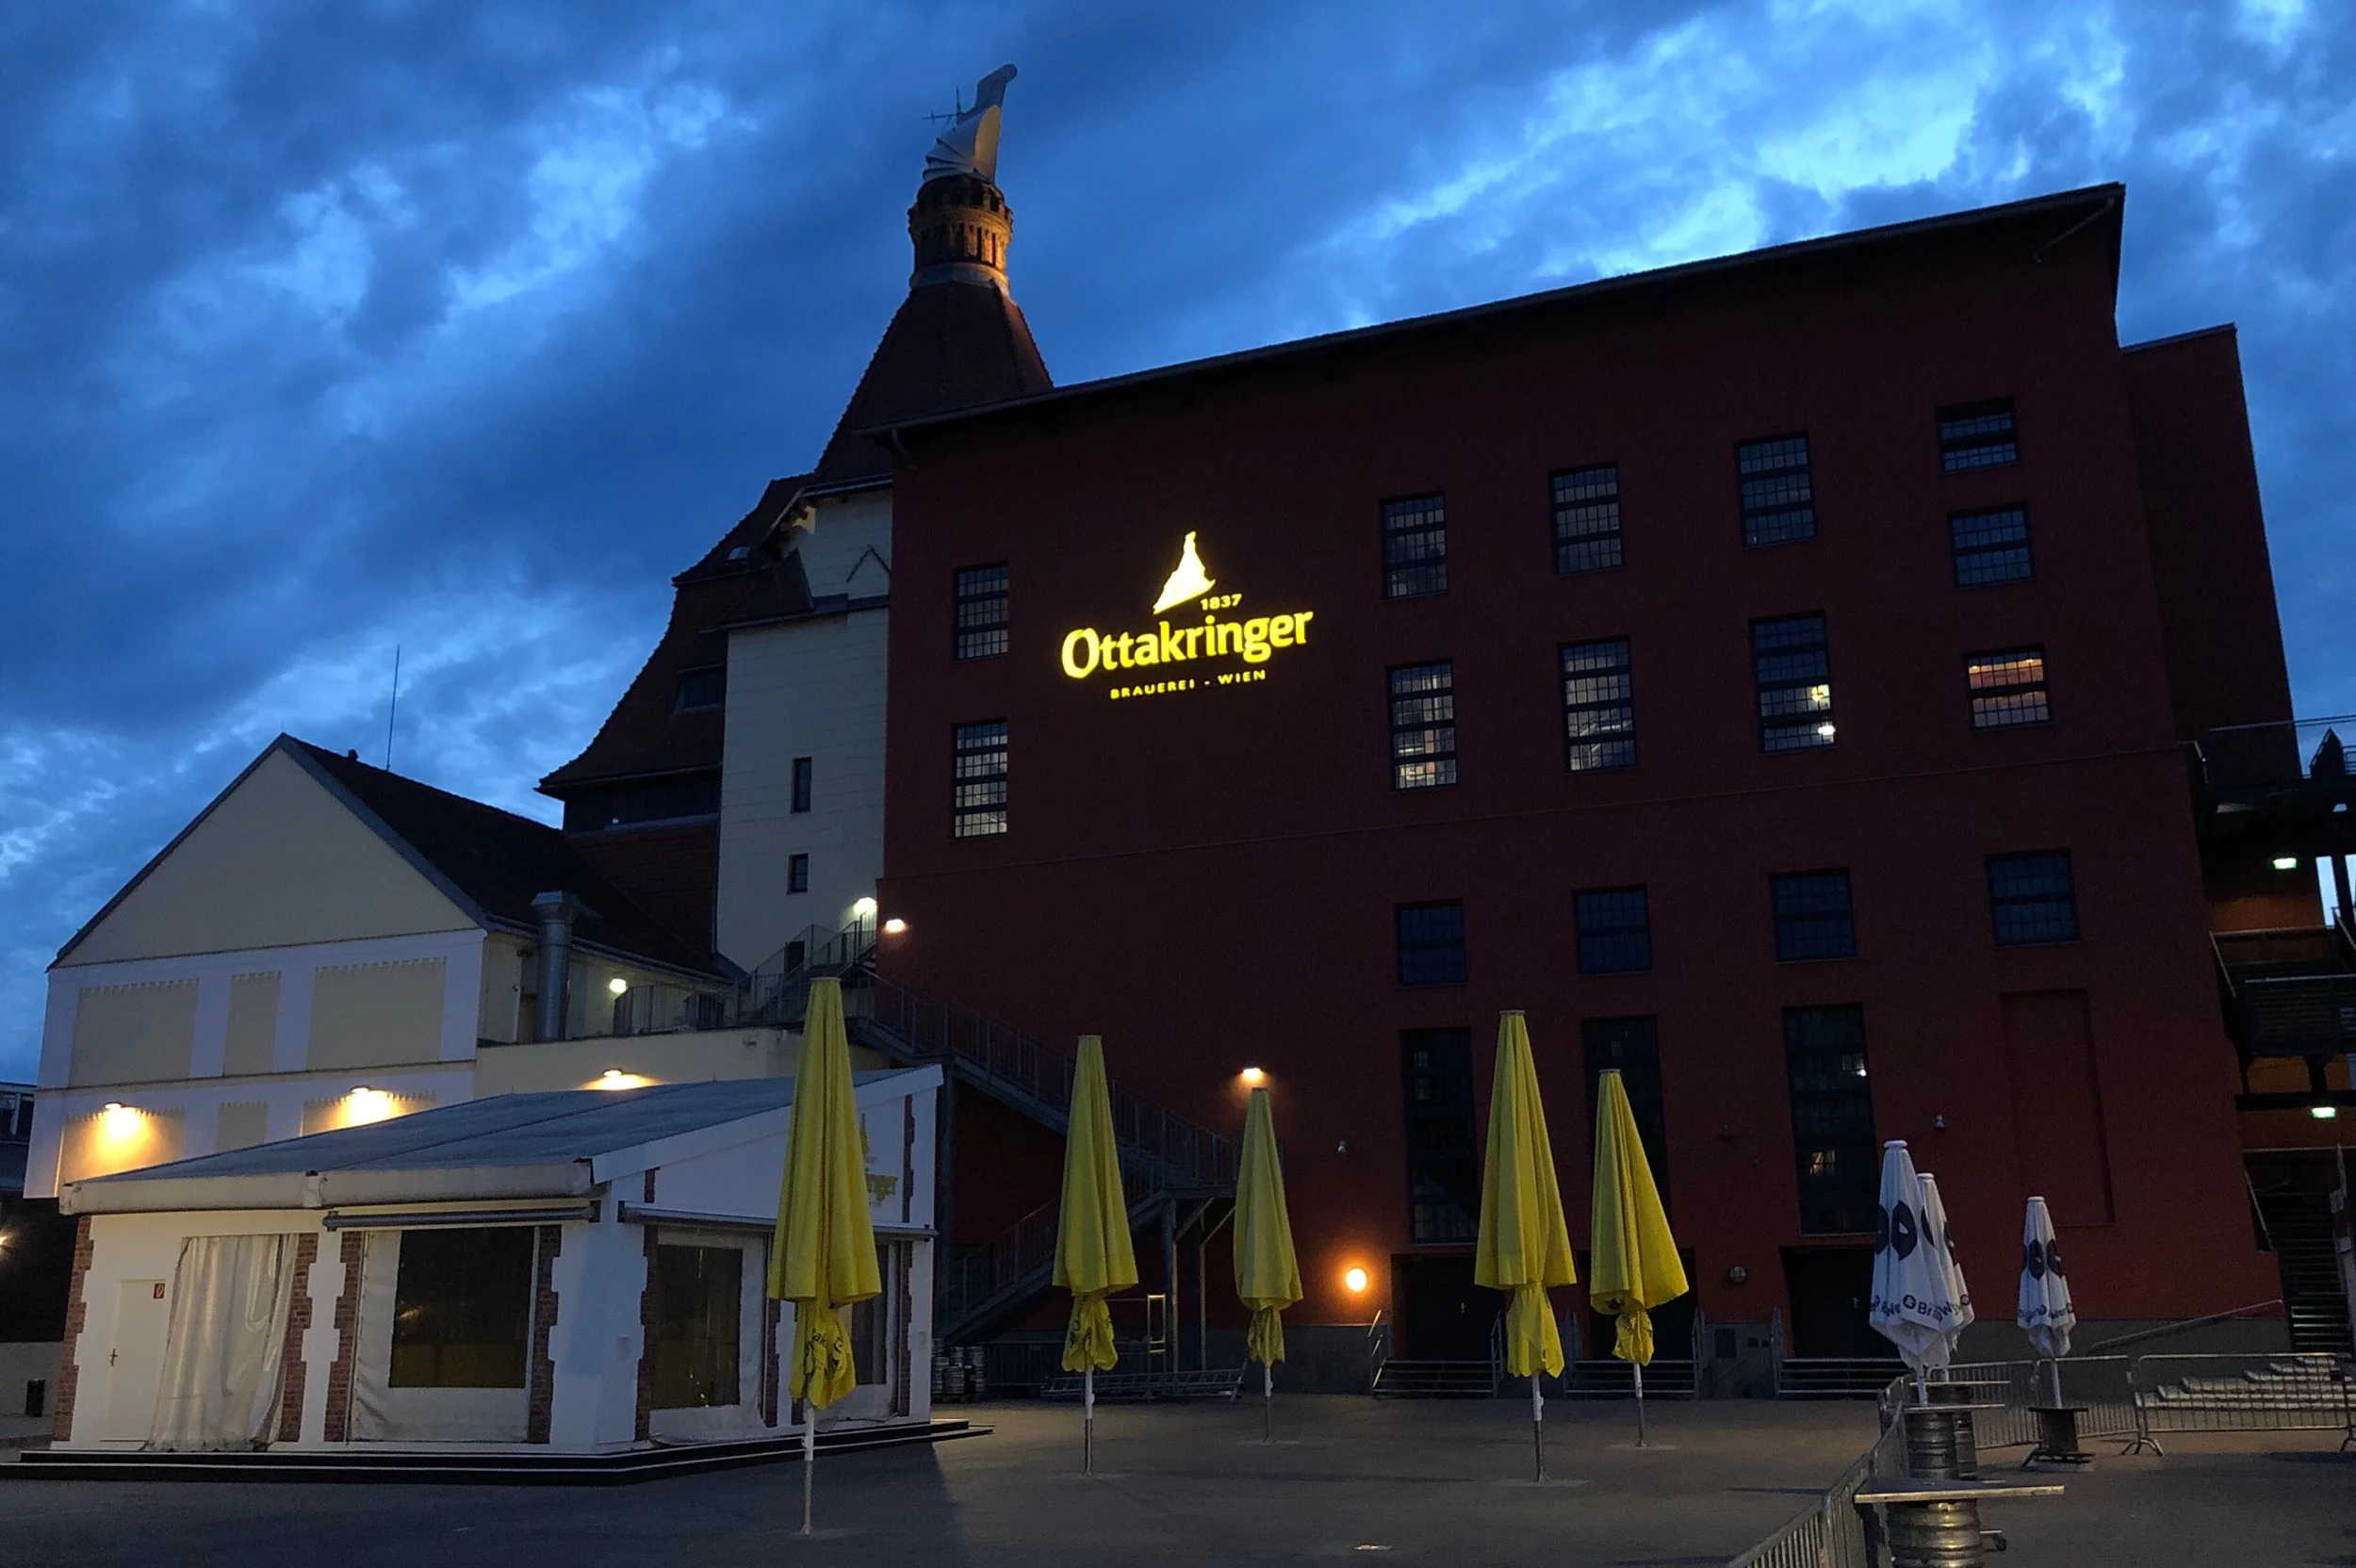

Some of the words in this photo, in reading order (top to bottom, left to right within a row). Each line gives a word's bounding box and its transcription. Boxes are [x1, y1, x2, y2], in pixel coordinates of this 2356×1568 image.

[1200, 593, 1243, 612] 1837
[1061, 611, 1315, 679] Ottakringer
[1109, 678, 1196, 700] BRAUEREI
[1217, 669, 1267, 685] WIEN
